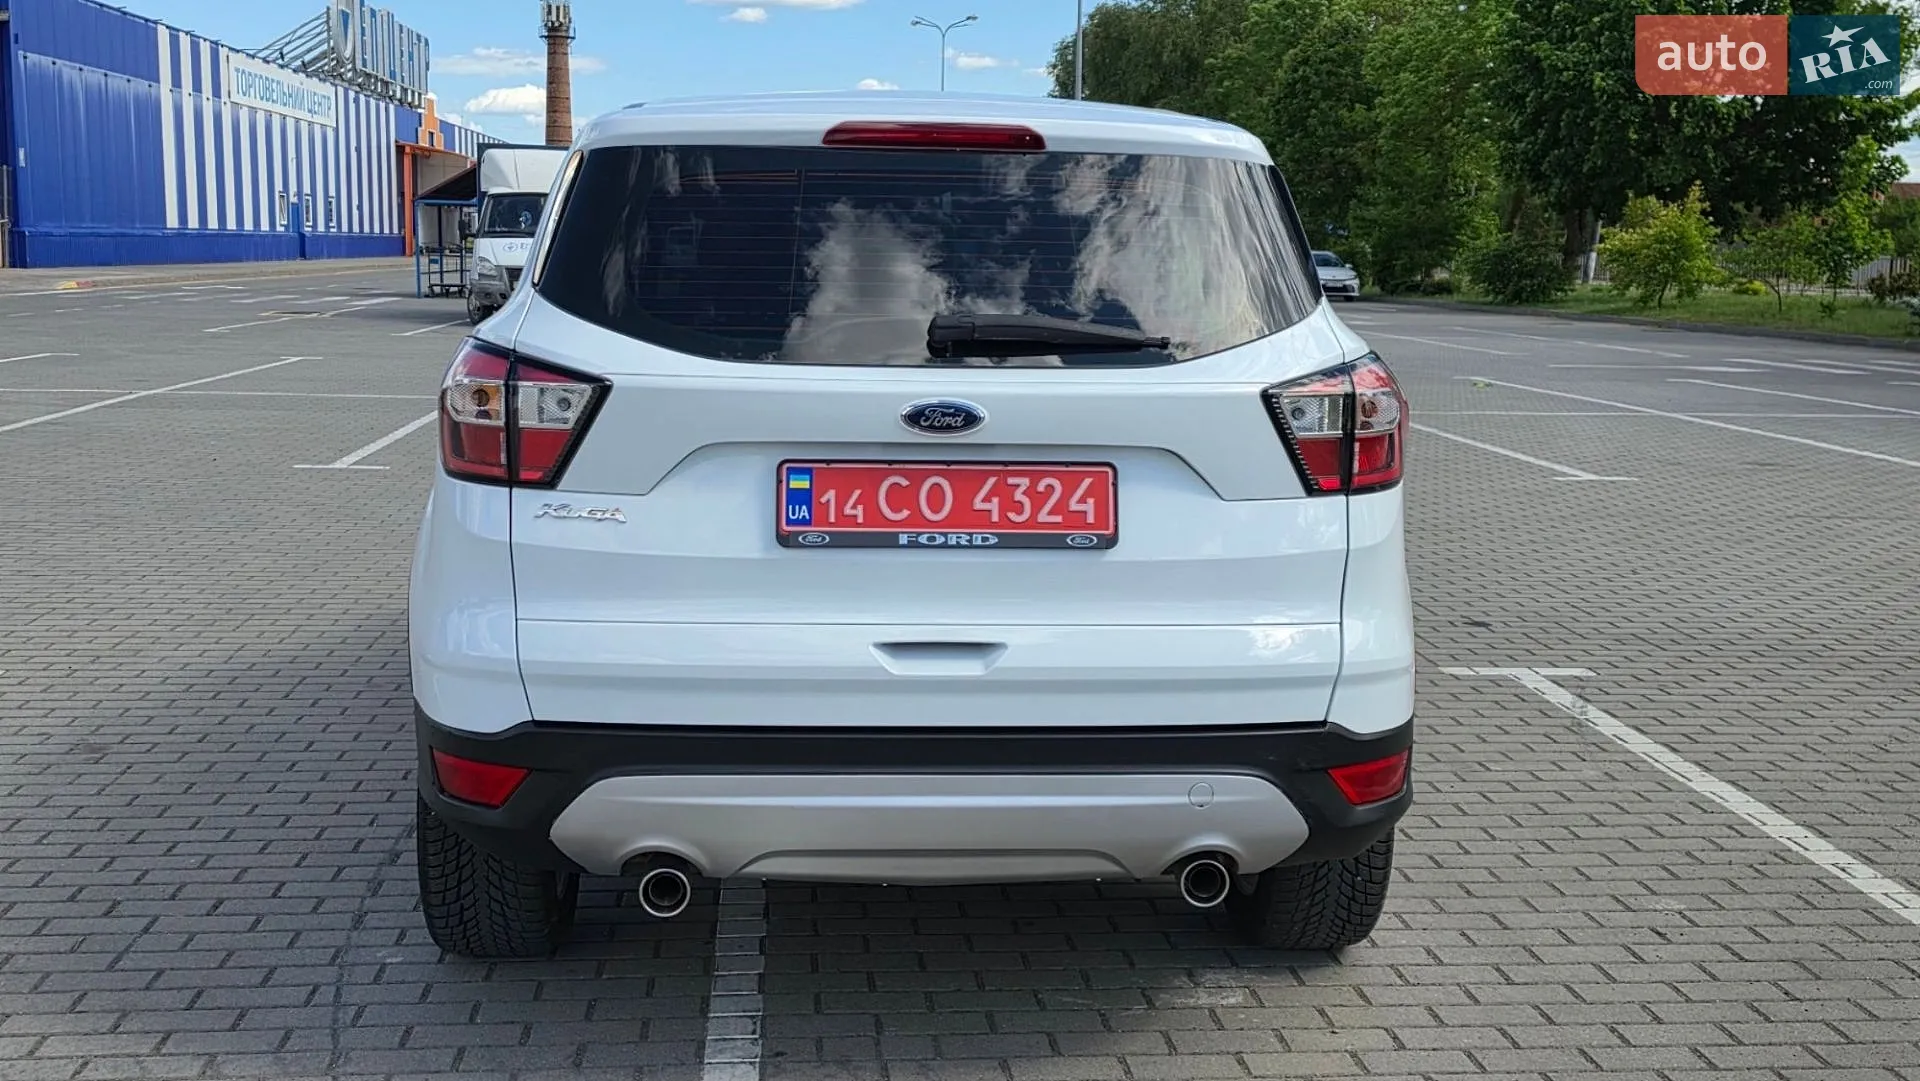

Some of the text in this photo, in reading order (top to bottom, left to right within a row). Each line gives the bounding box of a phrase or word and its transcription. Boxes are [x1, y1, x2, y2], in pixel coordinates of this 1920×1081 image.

[234, 67, 332, 117] ТОРГОВЕЛЬНИЙ ЦЕНТР
[919, 407, 966, 428] Ford
[788, 475, 1096, 524] UA 14 CO 4324
[898, 533, 999, 546] FORD
